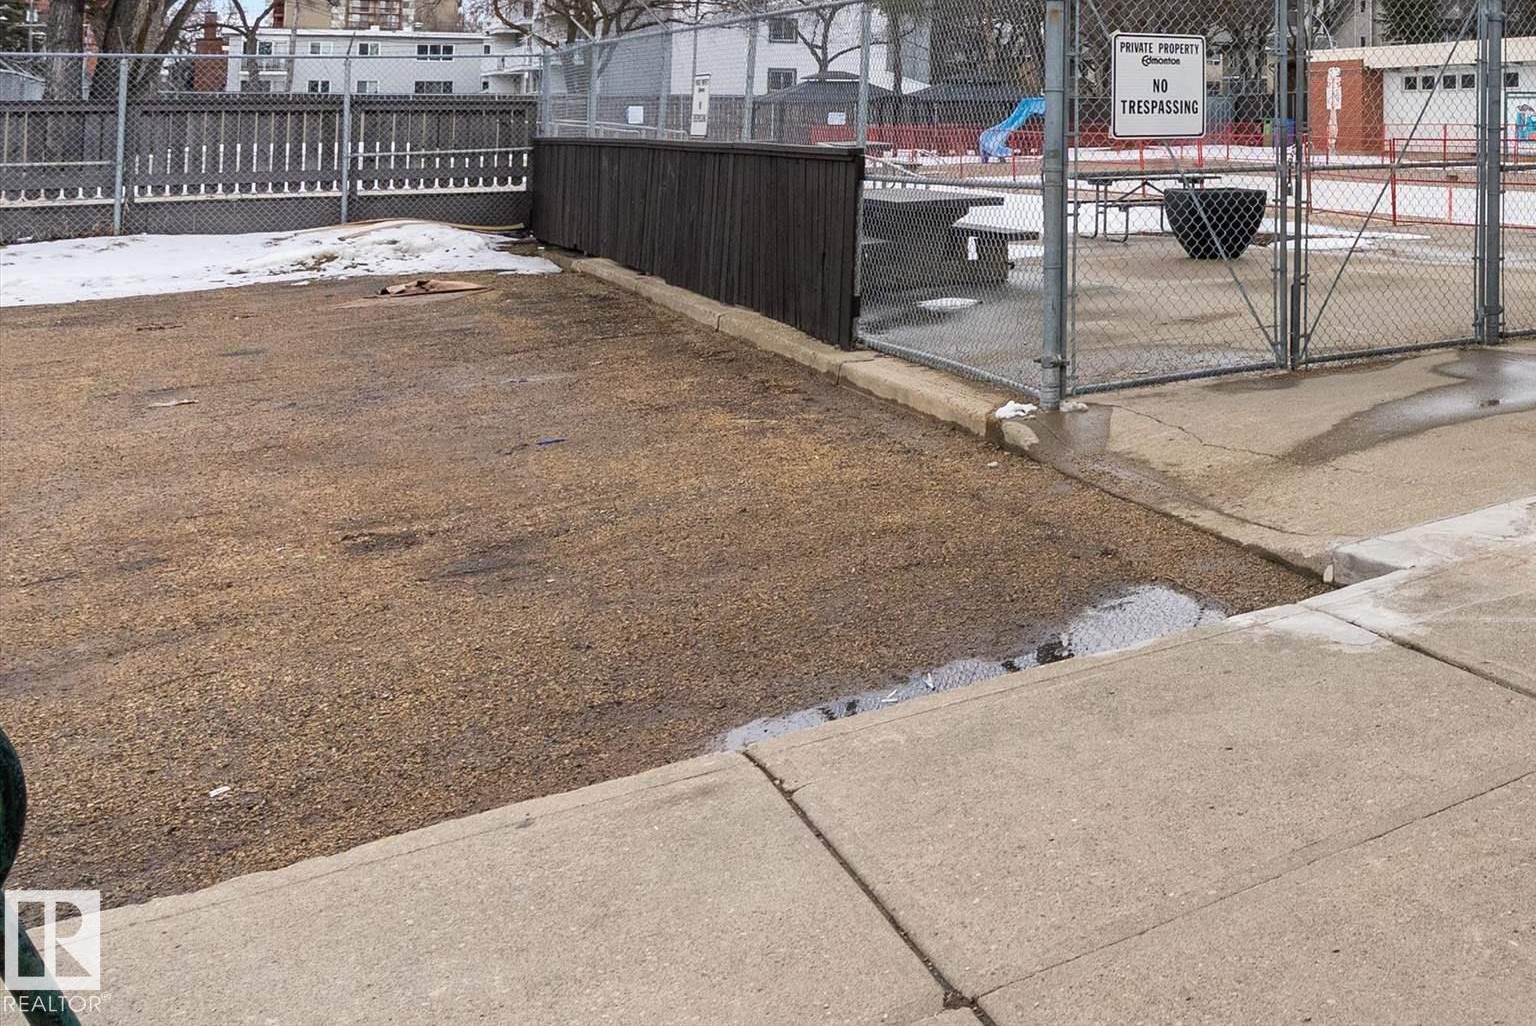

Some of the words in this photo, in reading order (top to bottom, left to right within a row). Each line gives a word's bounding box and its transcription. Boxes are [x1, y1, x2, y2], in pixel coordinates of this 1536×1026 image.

[1120, 42, 1153, 53] PRIVATE
[1158, 43, 1199, 54] PROPERTY
[1141, 55, 1180, 66] Edmonton
[1152, 79, 1168, 93] NO
[1121, 100, 1199, 114] TRESPASSING
